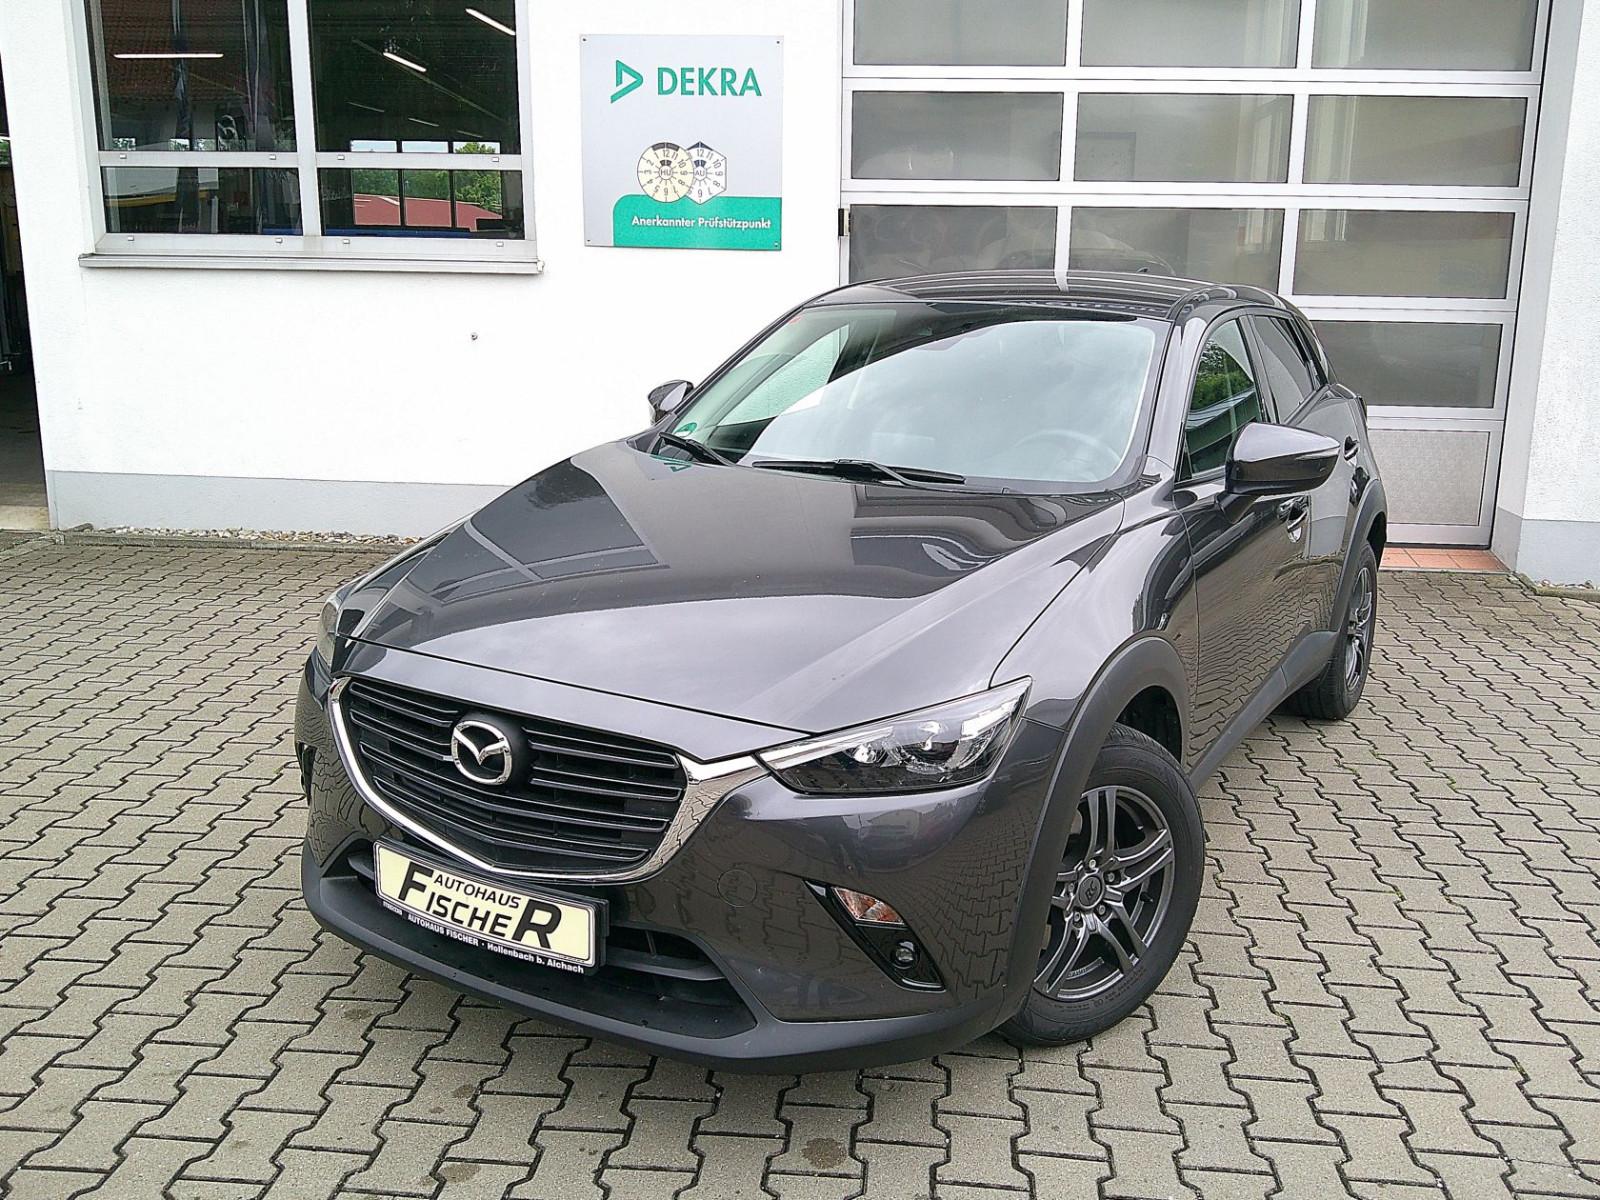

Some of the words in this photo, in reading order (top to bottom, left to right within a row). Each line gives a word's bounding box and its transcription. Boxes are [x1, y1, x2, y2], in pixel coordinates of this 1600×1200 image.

[657, 67, 762, 97] DEKRA
[631, 214, 696, 228] Anerkannter
[698, 216, 771, 231] Prüfstützpunkt
[433, 873, 522, 910] AUTOHAUS
[407, 913, 445, 935] AUTOHAUS
[446, 928, 479, 947] FISCHER
[487, 942, 535, 963] Hollenbach
[536, 955, 546, 966] b.
[547, 958, 584, 975] Aichach
